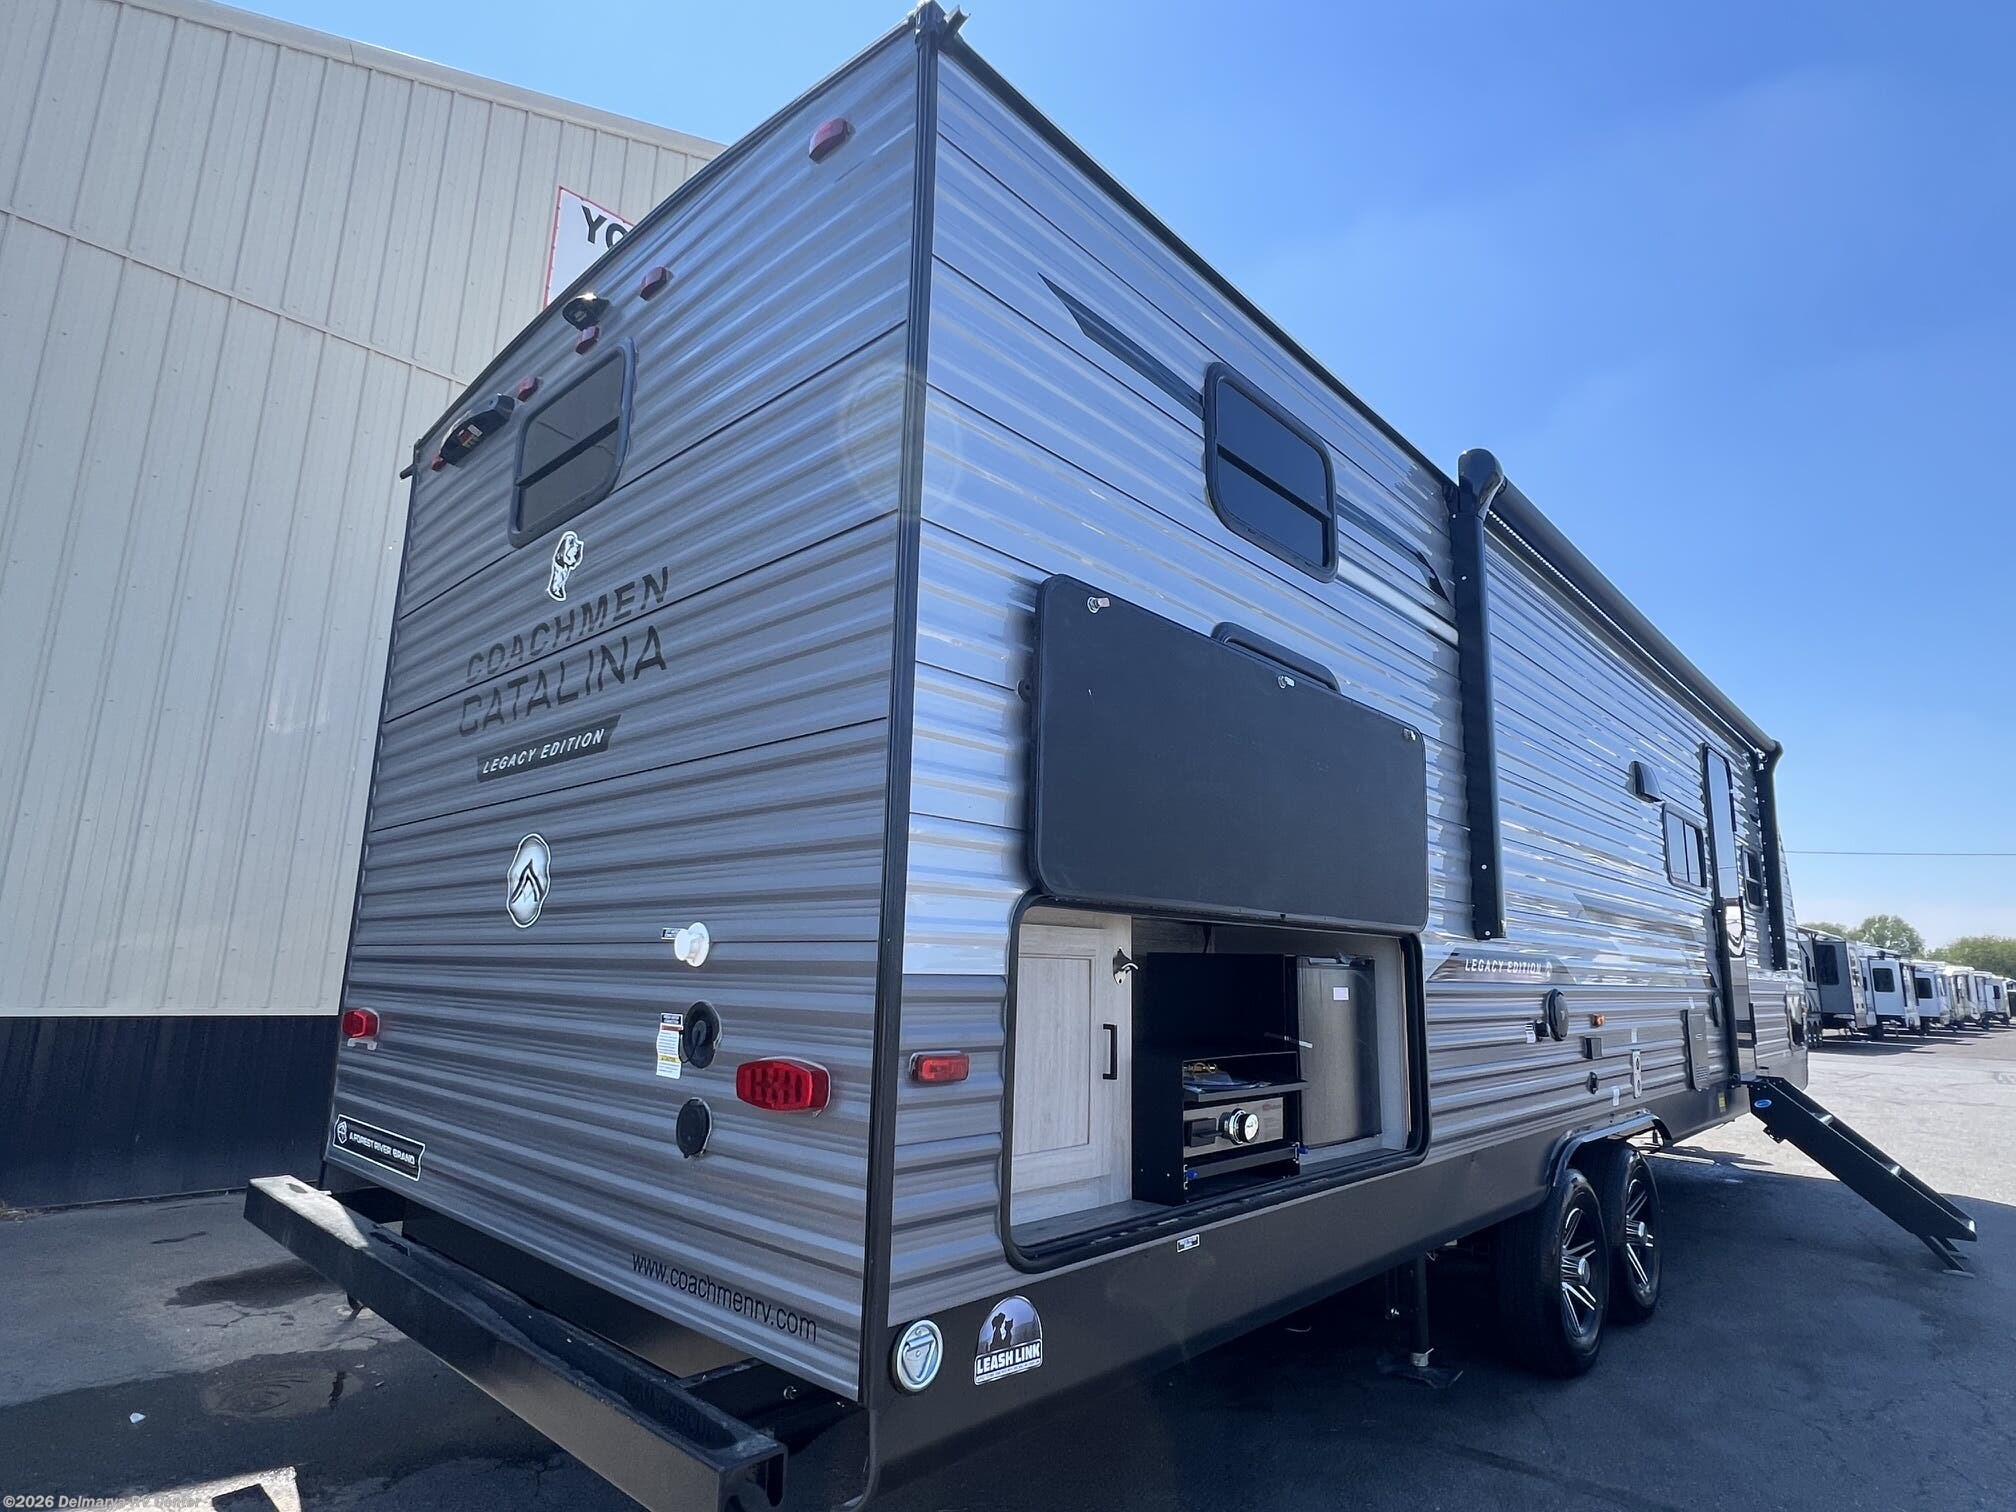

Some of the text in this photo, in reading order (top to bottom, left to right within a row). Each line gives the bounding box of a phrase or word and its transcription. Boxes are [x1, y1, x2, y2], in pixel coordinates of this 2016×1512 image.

[466, 566, 669, 683] COACHMEN
[458, 625, 667, 737] CATALINA
[482, 729, 604, 774] LEGACY EDITION
[1465, 959, 1543, 975] LEGACY EDITION
[353, 1133, 374, 1148] FOREST
[374, 1142, 392, 1156] RIVER
[393, 1149, 415, 1165] BRAND
[632, 1252, 817, 1343] www.coachmenrv.com
[977, 1350, 1014, 1375] LEASH
[1015, 1342, 1040, 1364] LINK
